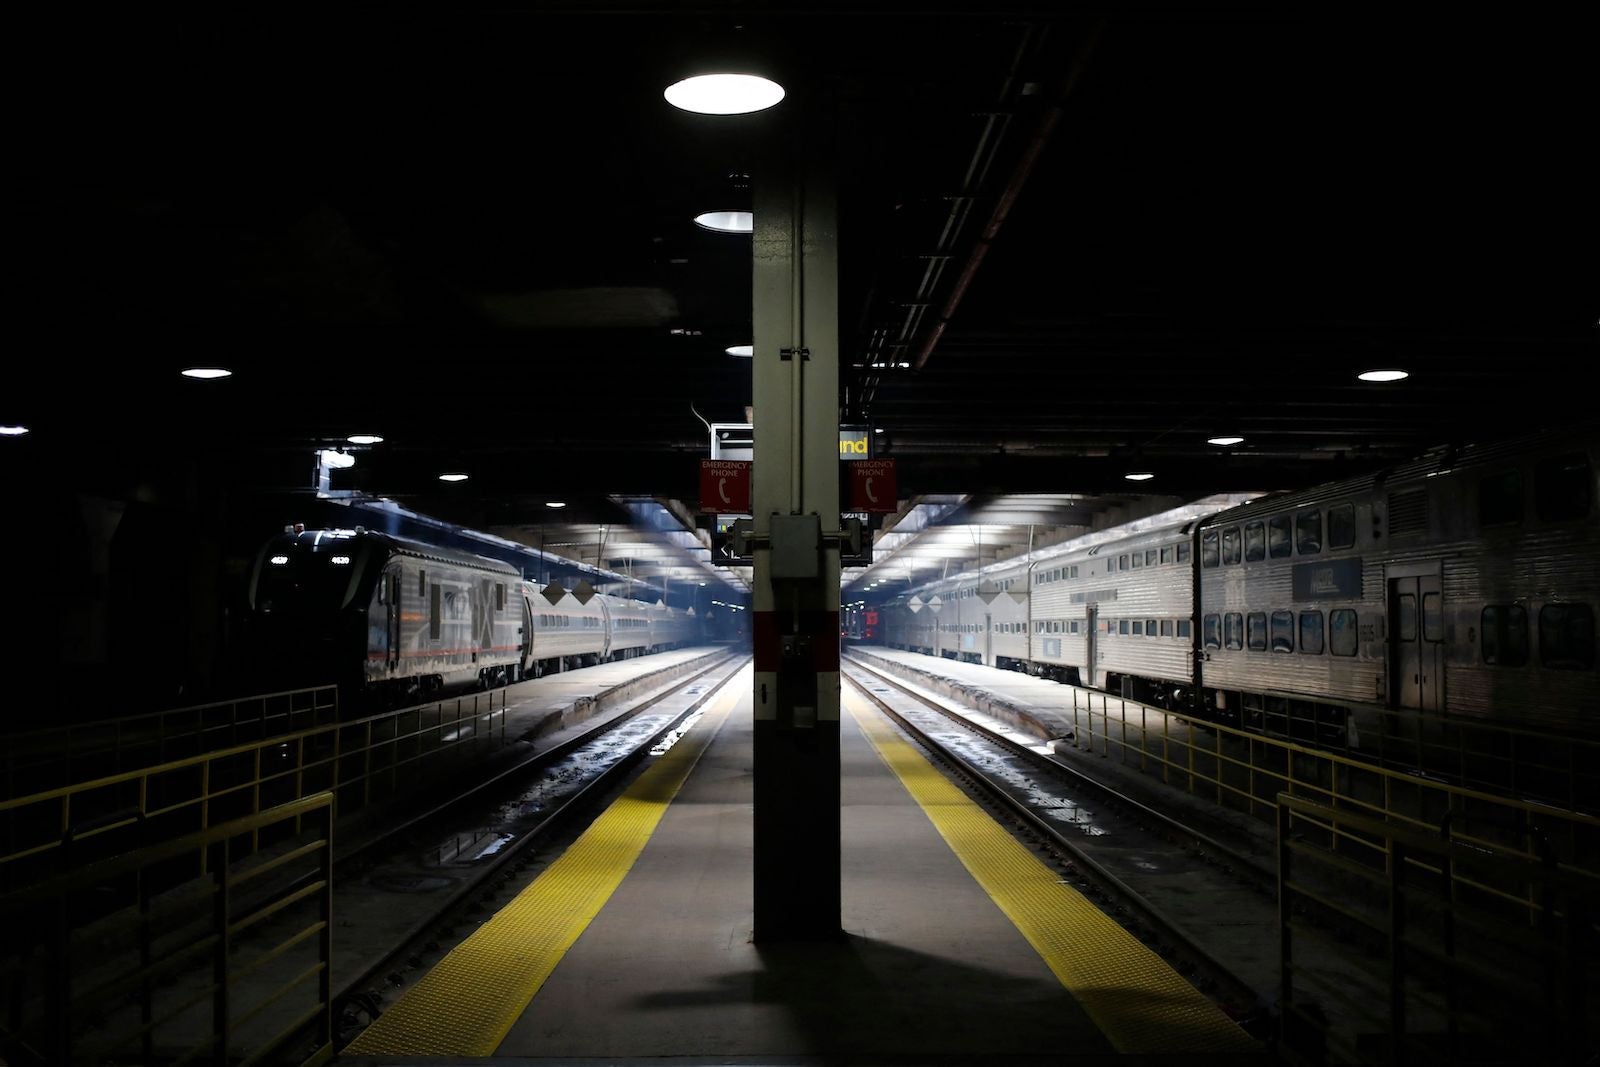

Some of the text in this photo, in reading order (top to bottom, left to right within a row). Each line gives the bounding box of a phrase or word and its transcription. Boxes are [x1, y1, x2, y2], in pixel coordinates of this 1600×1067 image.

[839, 437, 868, 454] nd
[702, 461, 748, 469] EMERGENCY
[850, 460, 893, 468] MERGENCY
[711, 469, 738, 477] PHONE
[857, 468, 884, 476] PHONE
